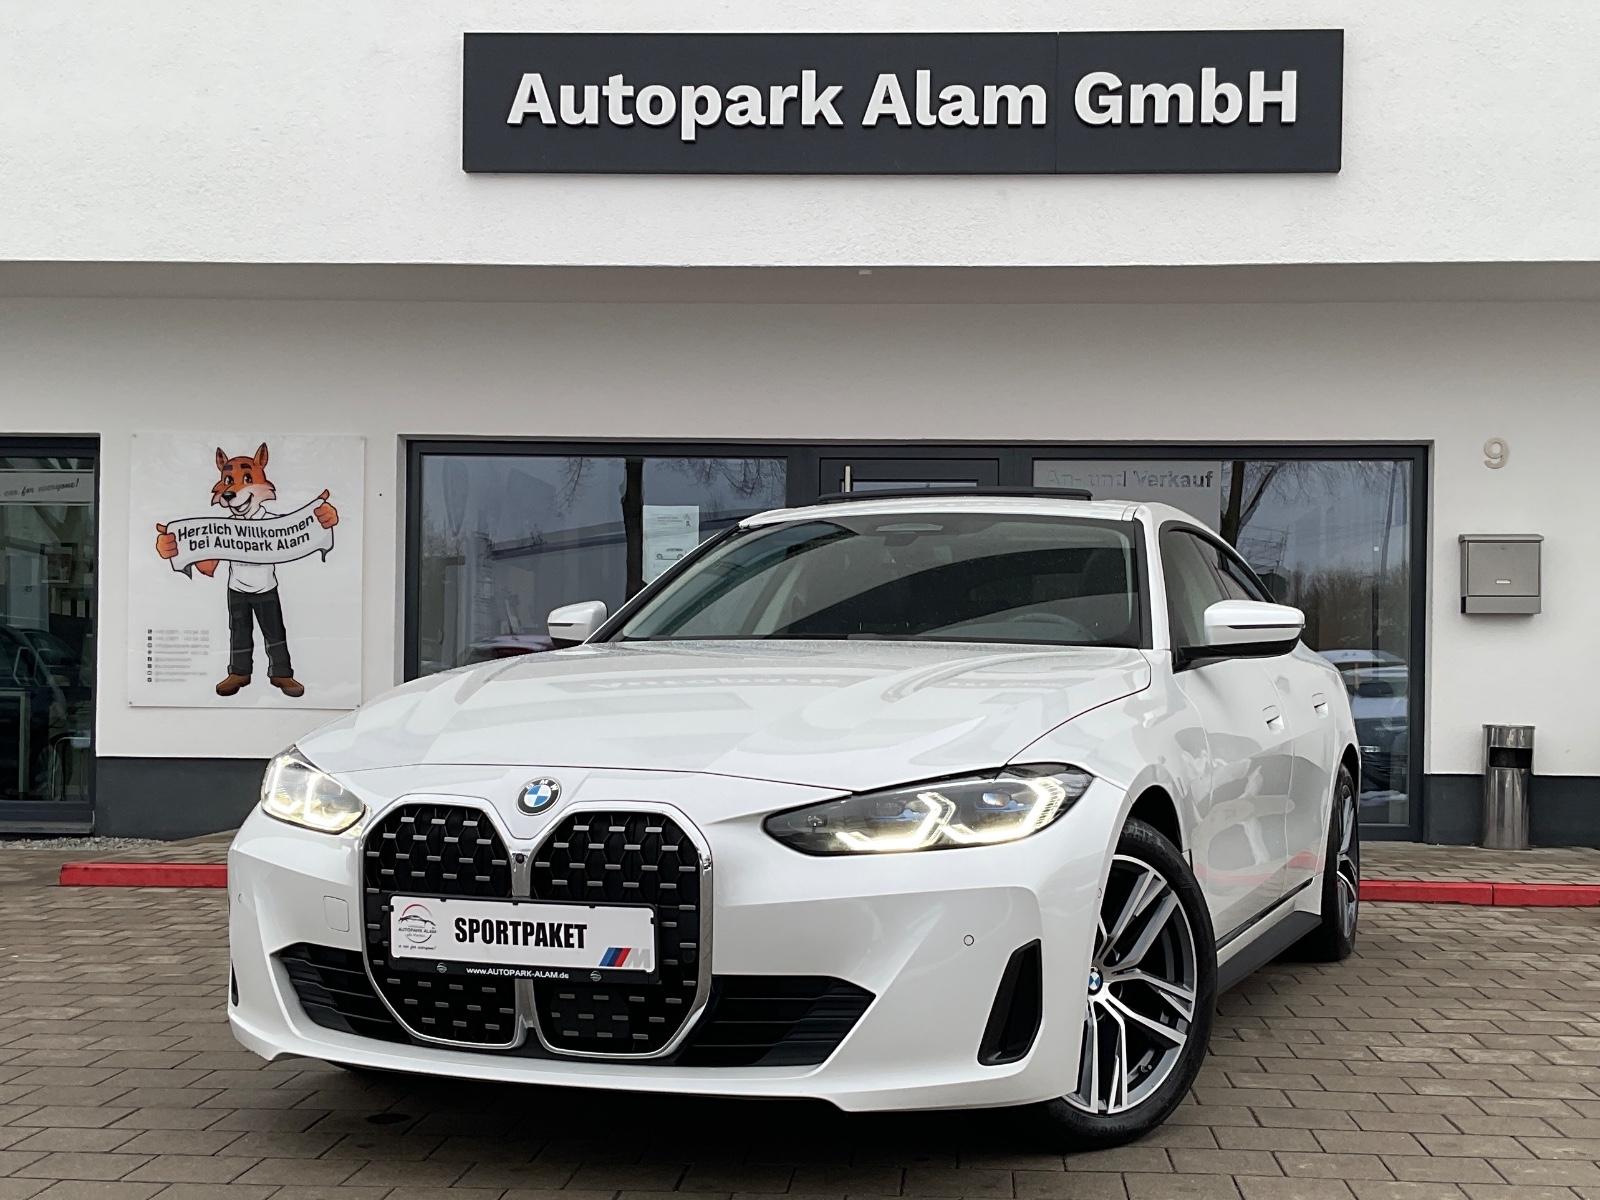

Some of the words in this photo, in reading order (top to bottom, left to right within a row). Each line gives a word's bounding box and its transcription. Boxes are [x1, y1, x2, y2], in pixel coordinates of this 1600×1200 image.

[506, 70, 843, 141] Autopark
[861, 69, 1047, 126] Alam
[1074, 67, 1297, 125] GmbH
[1483, 437, 1509, 469] 9
[1088, 470, 1126, 487] und
[1133, 470, 1213, 488] Verkauf
[178, 523, 231, 541] Herzlich
[234, 515, 314, 539] Willkommen
[189, 536, 210, 551] bei
[213, 536, 273, 552] Autopark
[277, 532, 310, 551] Alam
[526, 779, 559, 791] BMW
[454, 917, 588, 949] SPORTPAKET
[466, 967, 569, 979] www.AUTOPARK-ALAM.de
